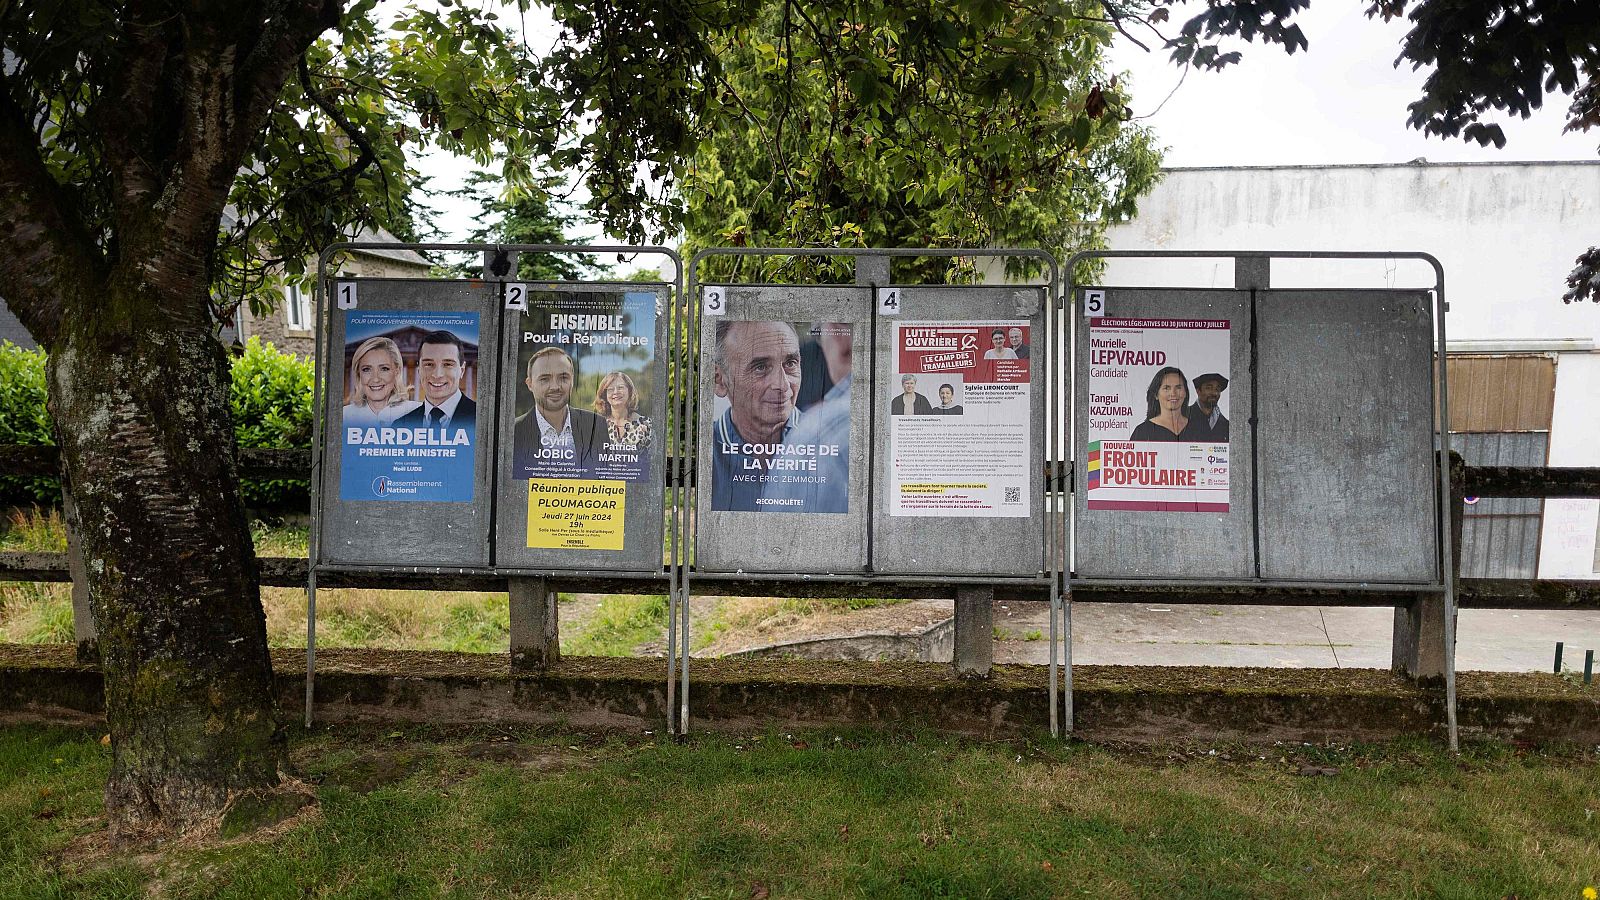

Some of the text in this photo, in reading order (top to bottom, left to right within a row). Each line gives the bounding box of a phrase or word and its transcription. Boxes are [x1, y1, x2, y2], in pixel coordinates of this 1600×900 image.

[342, 285, 350, 303] 1
[509, 287, 521, 304] 2
[884, 291, 898, 309] 4
[708, 292, 721, 310] 3
[1089, 294, 1101, 312] 5
[550, 314, 623, 330] ENSEMBLE
[524, 332, 648, 347] Pour la République
[905, 329, 937, 338] LUTTE
[905, 336, 957, 347] OUVRIÈRE
[1091, 339, 1127, 348] Murielle
[934, 354, 956, 362] CAMP
[1091, 350, 1166, 366] LEPVRAUD
[923, 360, 973, 370] TRAVAILLEURS
[1090, 368, 1128, 378] Candidate
[1090, 393, 1119, 405] Tangui
[1090, 406, 1133, 416] KAZUMBA
[1090, 419, 1128, 431] Suppléant
[347, 427, 470, 446] BARDELLA
[541, 436, 568, 448] Cyril
[359, 448, 456, 457] PREMIER MINISTRE
[534, 449, 574, 459] JOBIC
[722, 443, 839, 456] LE COURAGE DE
[598, 454, 638, 463] MARTIN
[743, 456, 817, 471] LA VÉRITÉ
[1103, 451, 1158, 468] FRONT
[759, 473, 779, 483] ÉRIC
[781, 475, 826, 483] ZEMMOUR
[1103, 468, 1197, 486] POPULAIRE
[531, 483, 624, 496] Réunion publique
[538, 499, 616, 509] PLOUMAGOAR
